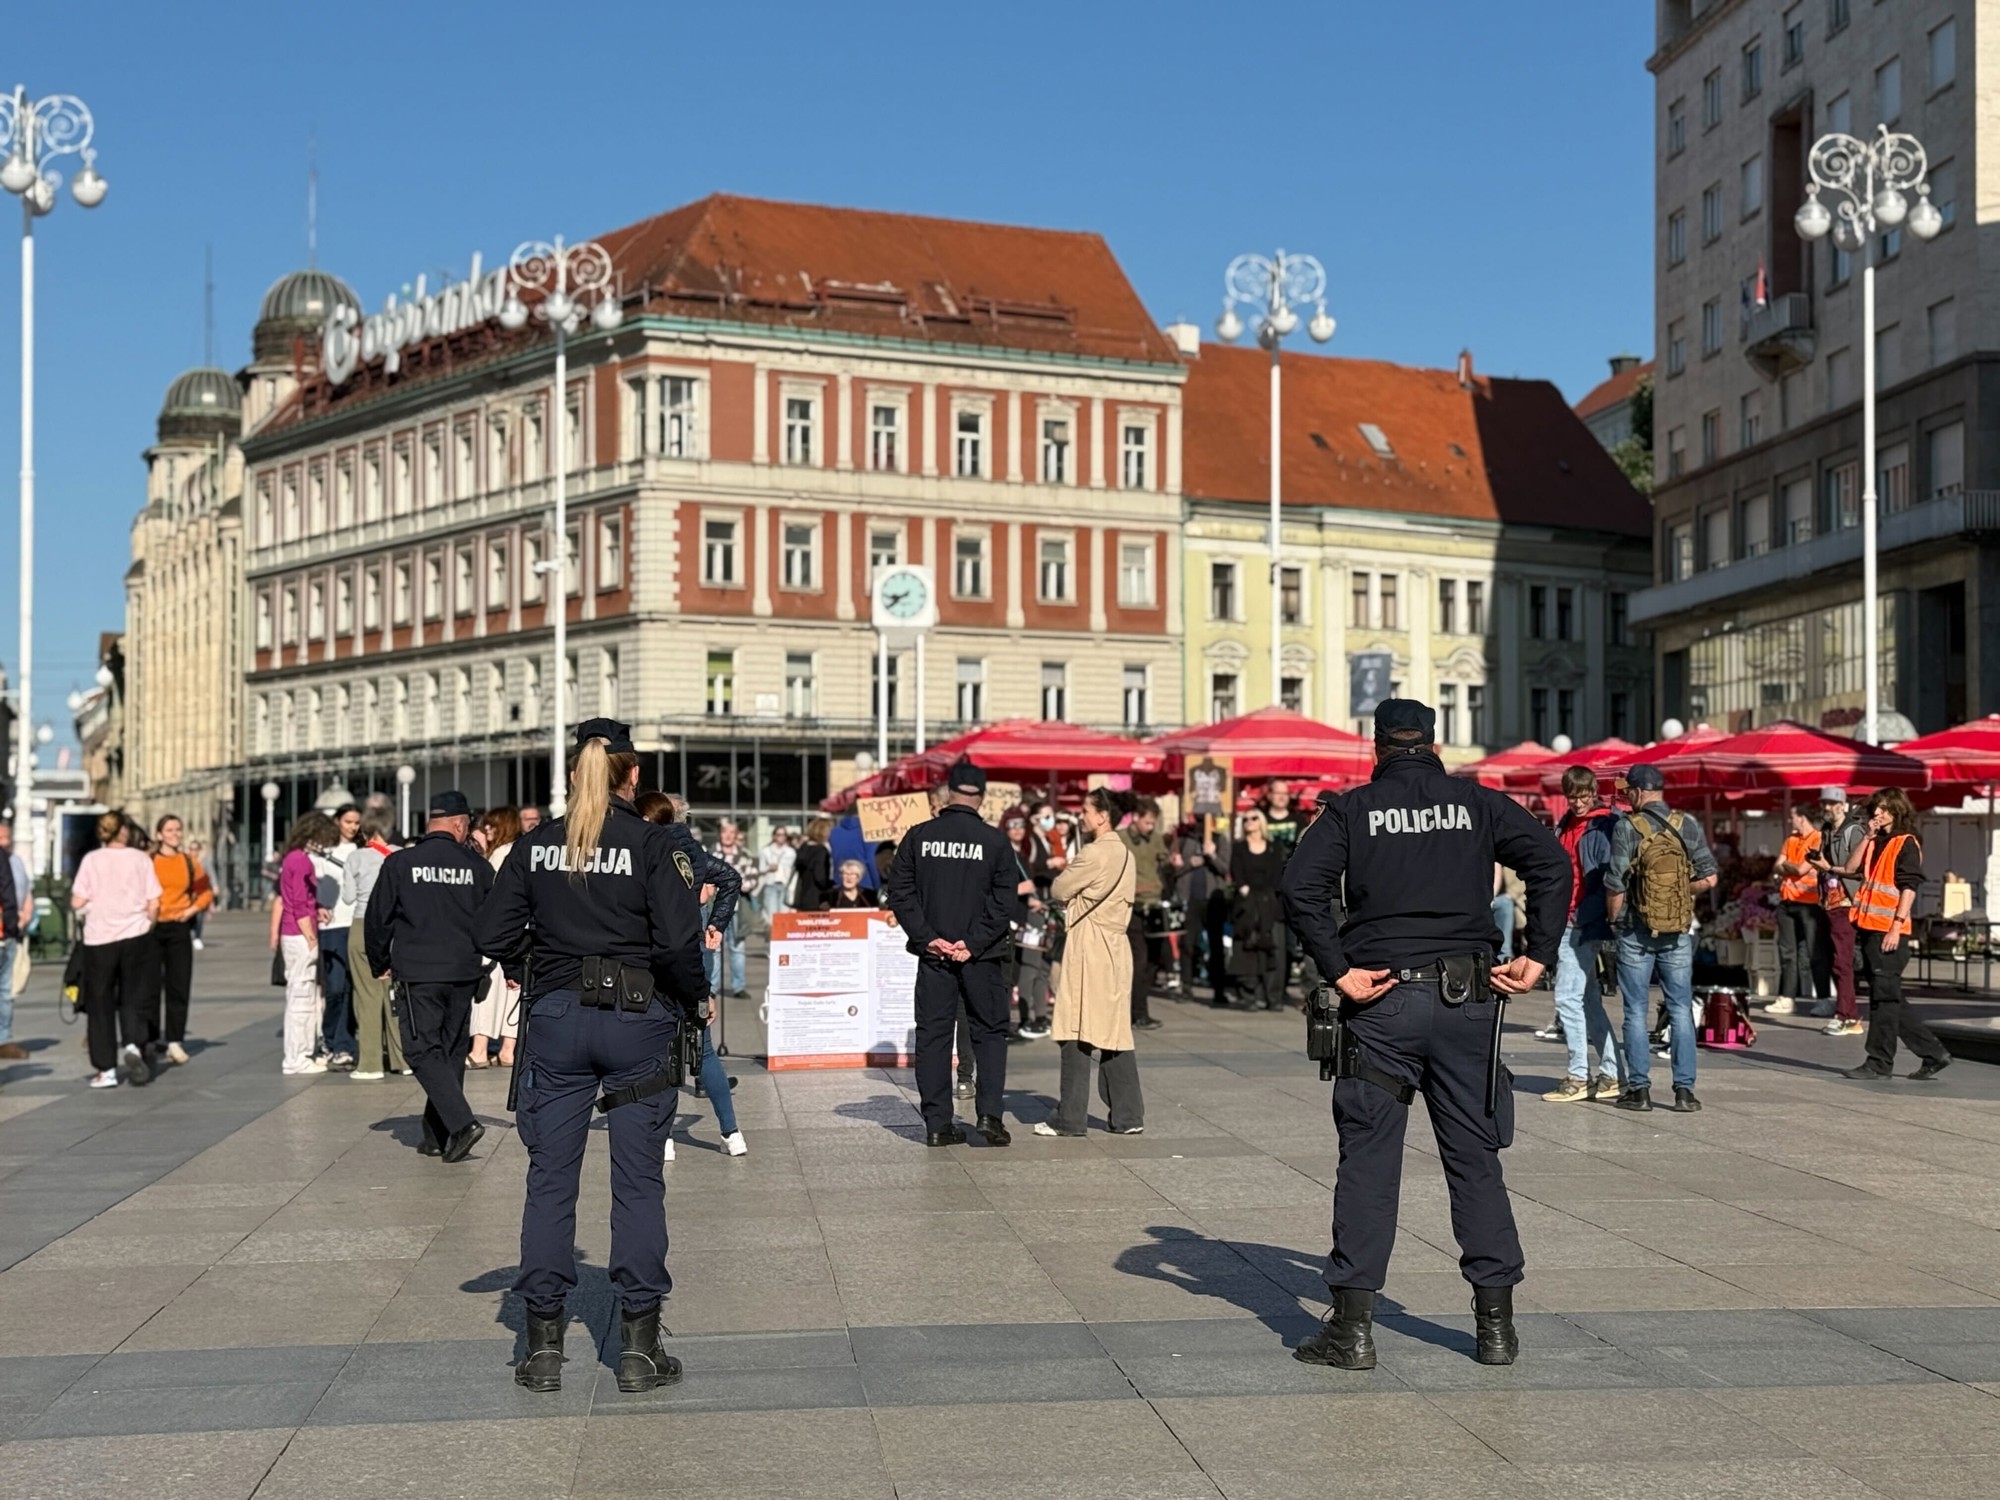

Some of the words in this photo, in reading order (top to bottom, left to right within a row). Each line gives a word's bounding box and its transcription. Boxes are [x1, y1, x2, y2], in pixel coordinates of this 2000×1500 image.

[1368, 804, 1473, 836] POLICIJA
[921, 841, 983, 861] POLICIJA
[411, 866, 475, 885] POLICIJA
